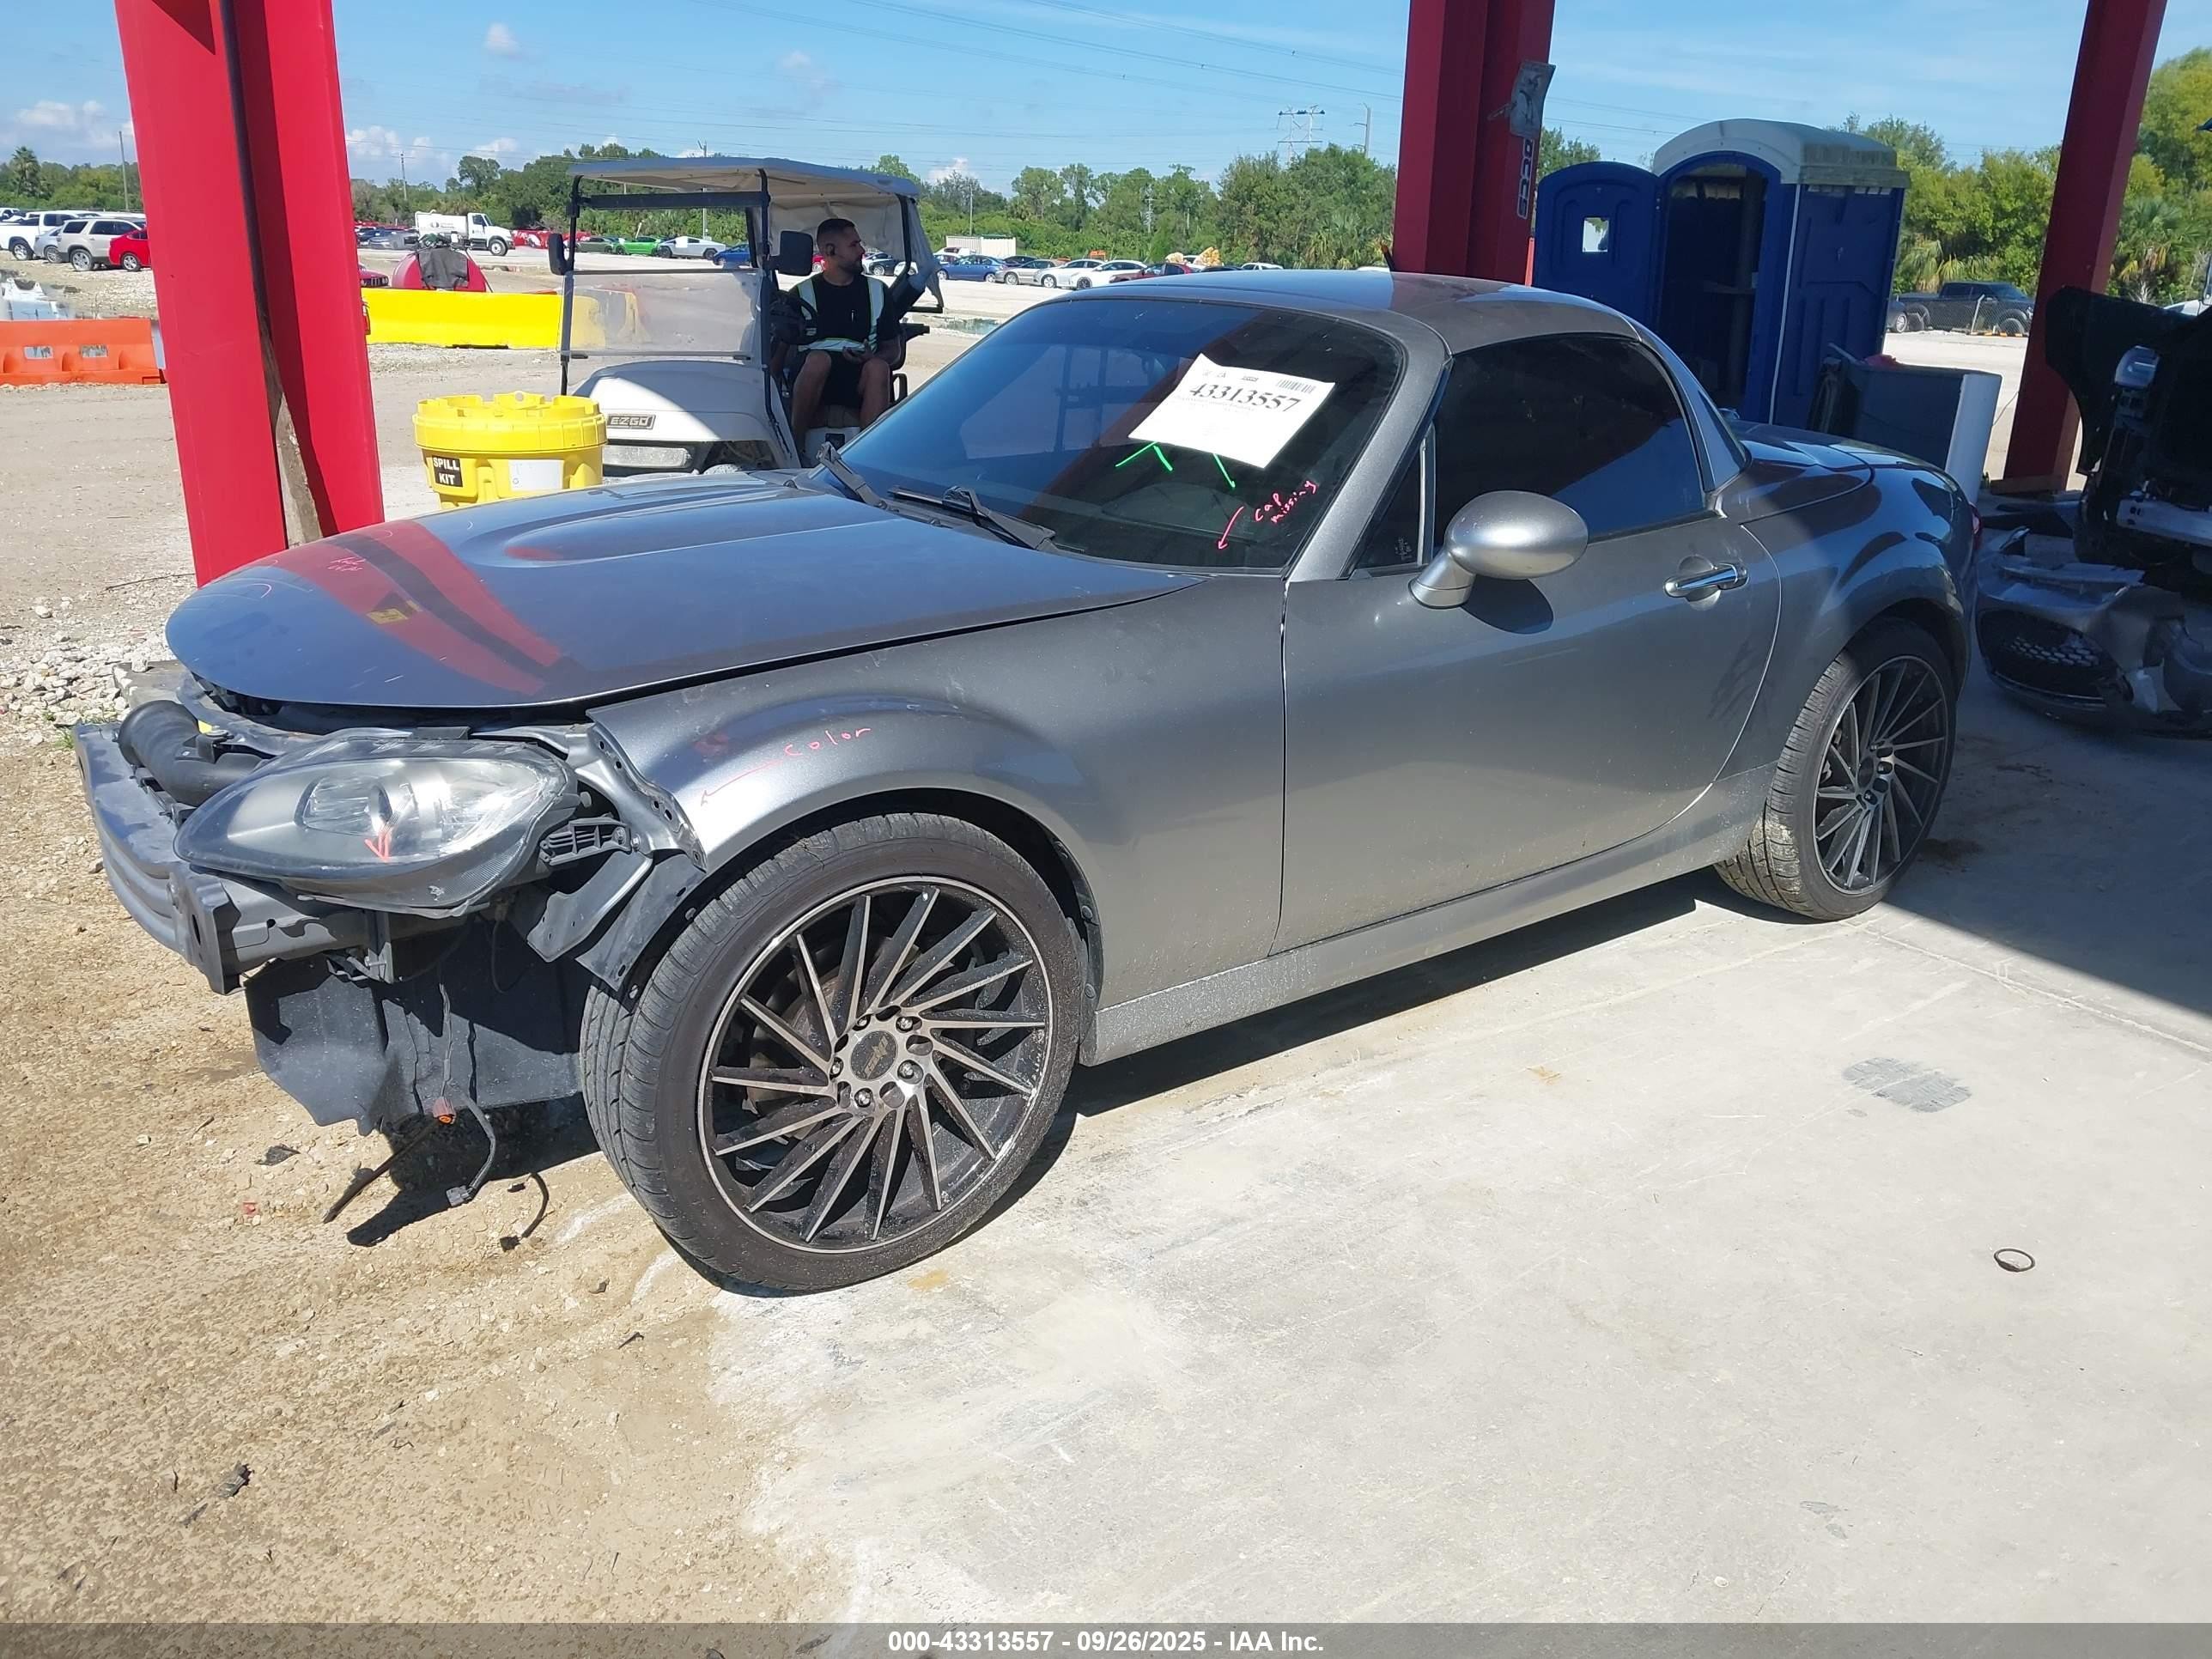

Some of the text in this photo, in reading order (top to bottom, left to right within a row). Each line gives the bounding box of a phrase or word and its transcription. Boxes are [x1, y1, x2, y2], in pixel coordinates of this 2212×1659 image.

[1189, 383, 1301, 412] 43313557
[610, 416, 649, 426] EZGO
[433, 457, 460, 471] SPILL
[438, 472, 456, 486] KIT
